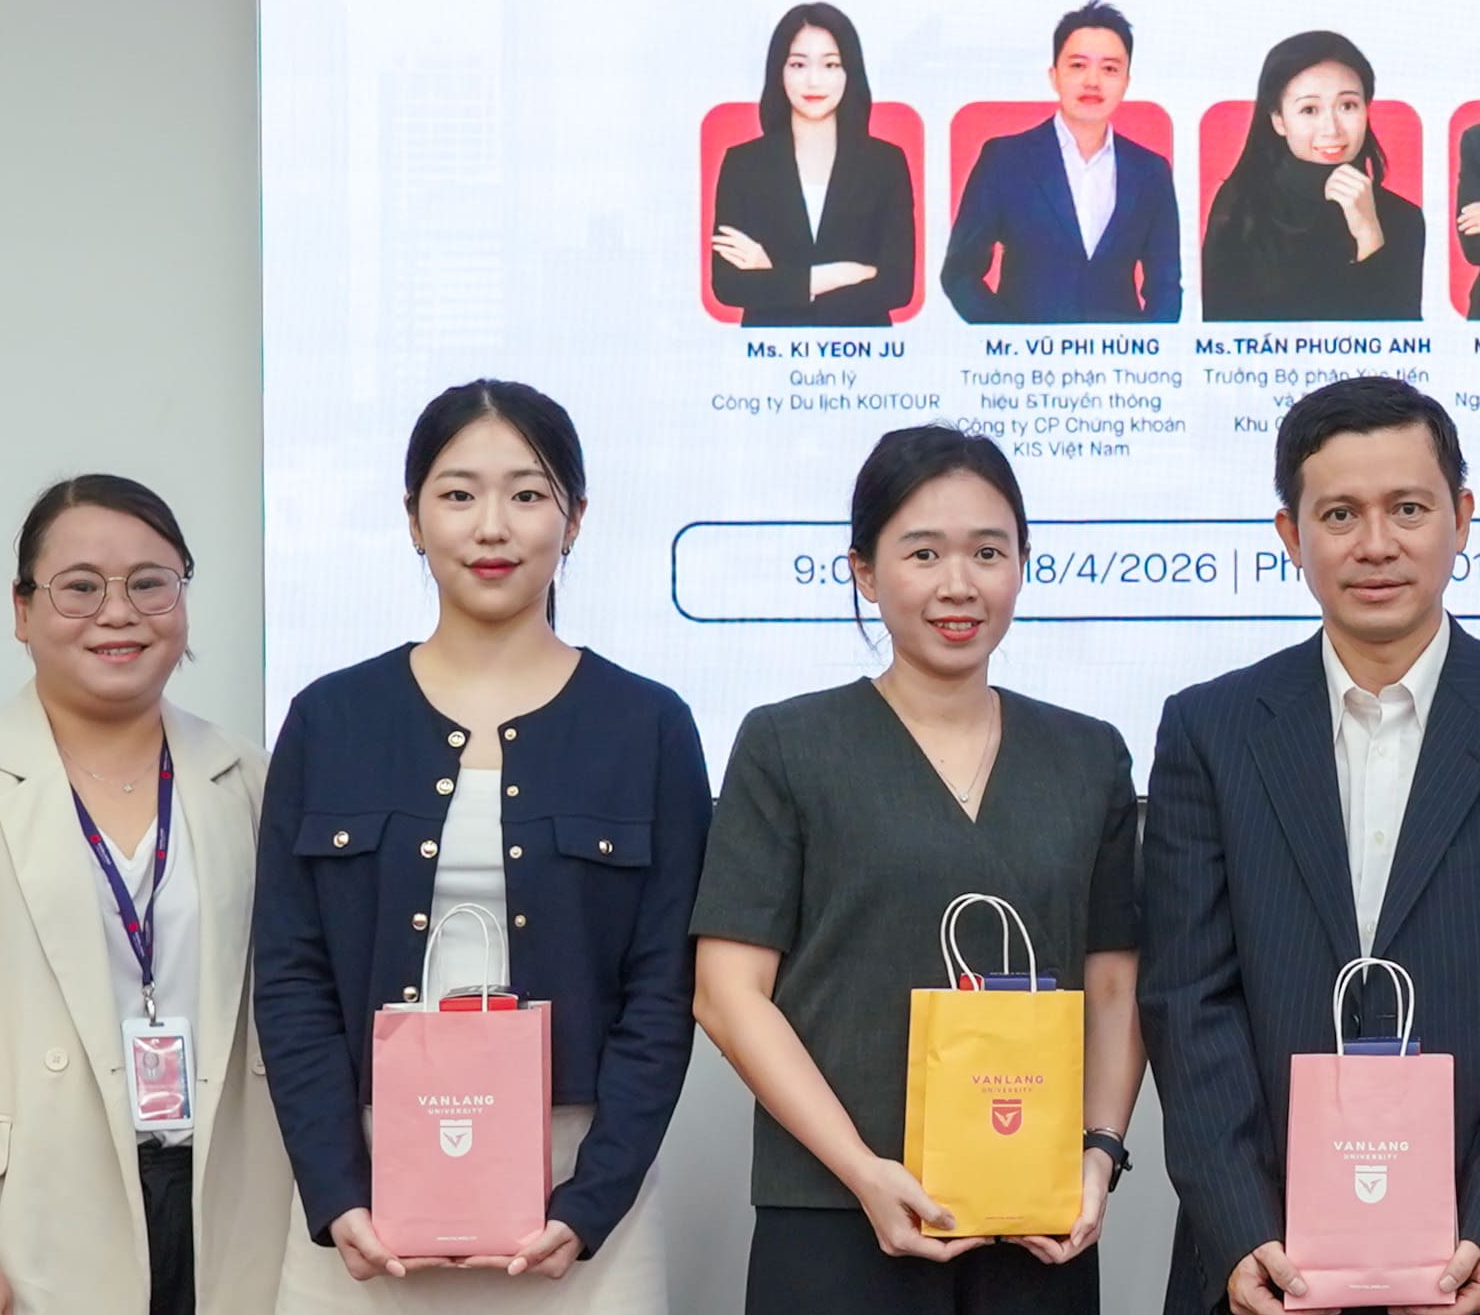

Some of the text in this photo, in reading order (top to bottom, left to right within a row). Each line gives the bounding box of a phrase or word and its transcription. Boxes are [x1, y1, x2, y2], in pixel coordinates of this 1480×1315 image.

[748, 342, 904, 357] Ms. KI YEON JU
[986, 335, 1159, 355] Mr. VŨ PHI HÙNG
[1296, 337, 1381, 354] PHƯƠNG
[1389, 338, 1430, 353] ANH
[767, 396, 783, 414] ty
[791, 394, 813, 410] Du
[857, 394, 940, 410] KOITOUR
[1011, 420, 1028, 437] ty
[1034, 417, 1060, 434] CP
[1235, 417, 1268, 432] Khu
[1014, 441, 1042, 457] KIS
[1091, 441, 1129, 456] Nam
[971, 1075, 1043, 1085] VANLANG
[418, 1095, 494, 1106] VANLANG
[1333, 1141, 1408, 1151] VANLANG
